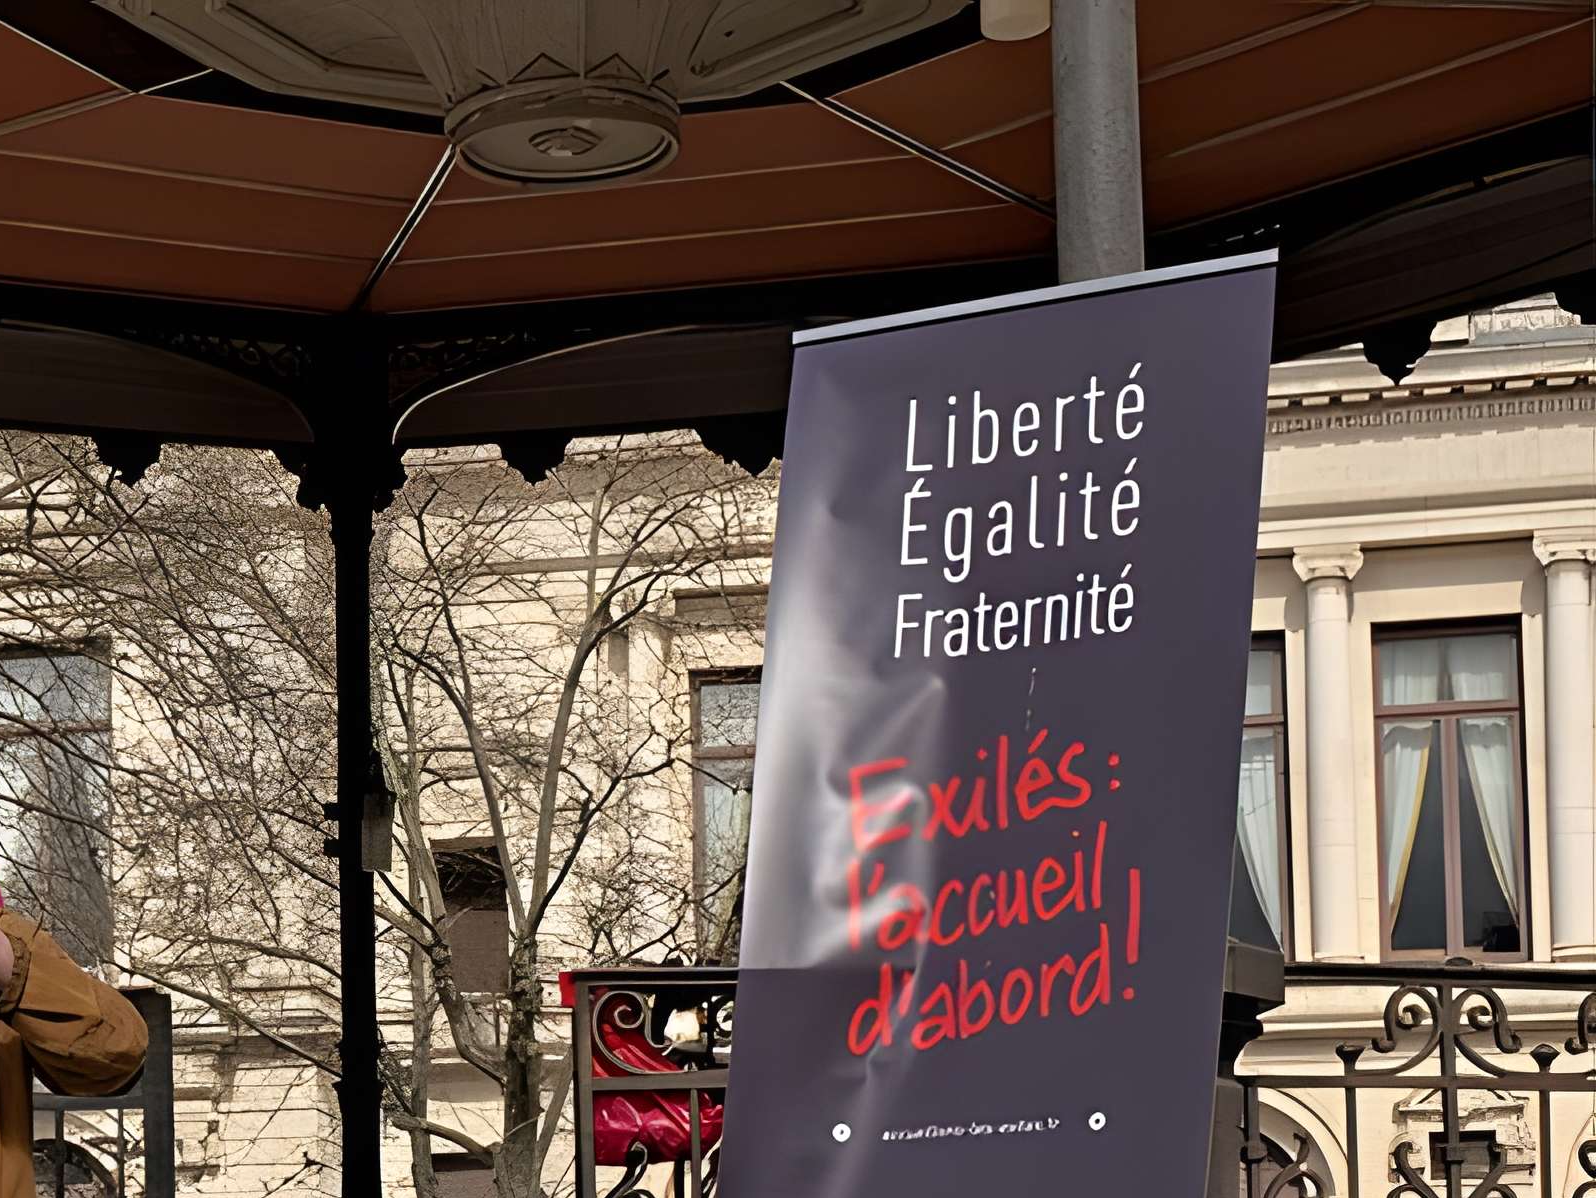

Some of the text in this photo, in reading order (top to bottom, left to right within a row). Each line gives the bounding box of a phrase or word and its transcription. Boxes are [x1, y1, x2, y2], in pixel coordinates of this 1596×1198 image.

[906, 362, 1146, 472] Liberté
[899, 458, 1141, 583] Égalité
[893, 563, 1135, 658] Fraternité
[846, 820, 1107, 951] l'accueil
